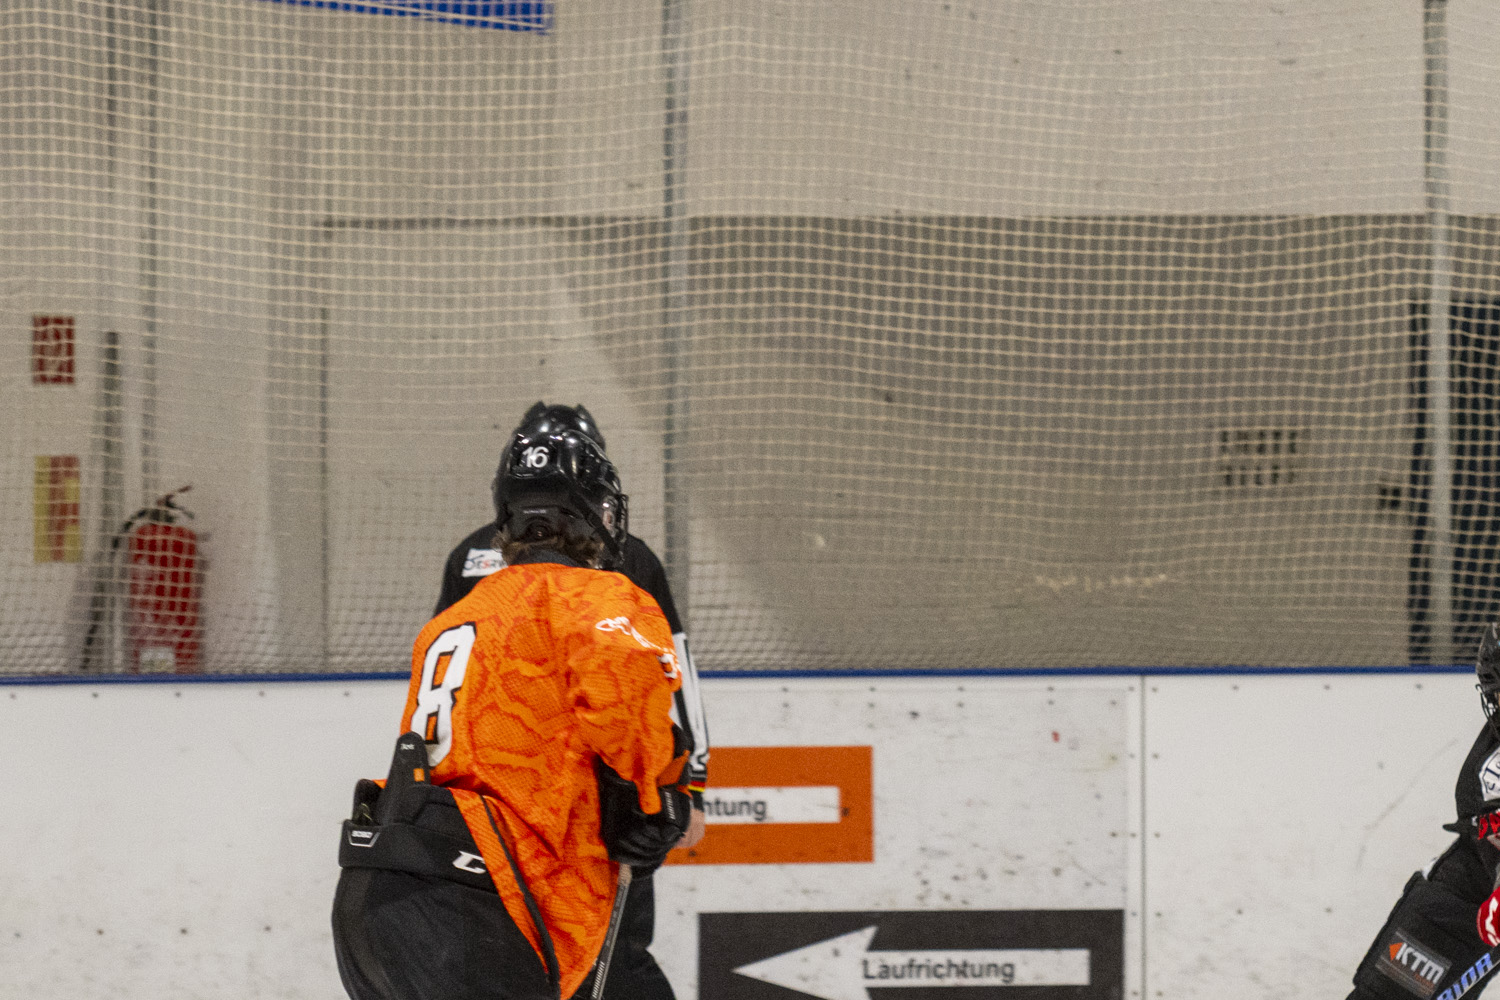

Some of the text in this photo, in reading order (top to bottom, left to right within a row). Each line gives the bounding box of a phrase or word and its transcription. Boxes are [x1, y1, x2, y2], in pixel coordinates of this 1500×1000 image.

[521, 446, 549, 468] 16
[862, 957, 1015, 983] Laufrichtung
[1397, 942, 1445, 985] KTM
